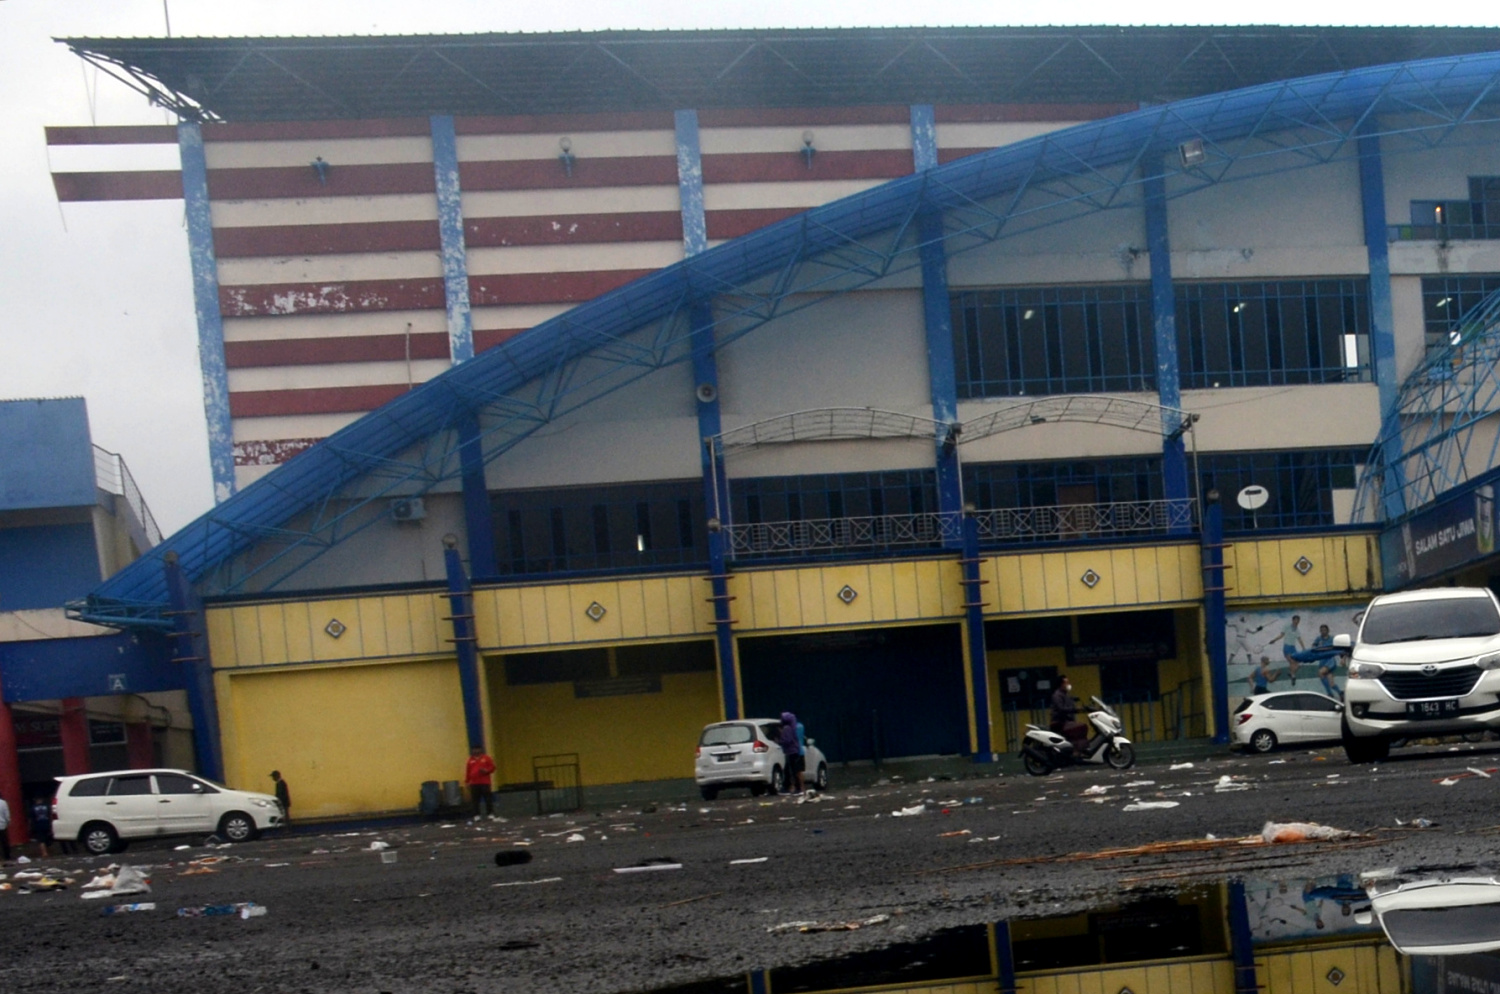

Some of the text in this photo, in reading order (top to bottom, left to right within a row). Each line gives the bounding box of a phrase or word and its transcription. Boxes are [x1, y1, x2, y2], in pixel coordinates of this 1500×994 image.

[1415, 533, 1438, 555] SALAM
[1438, 525, 1456, 546] SATU
[1457, 518, 1475, 539] JIWA
